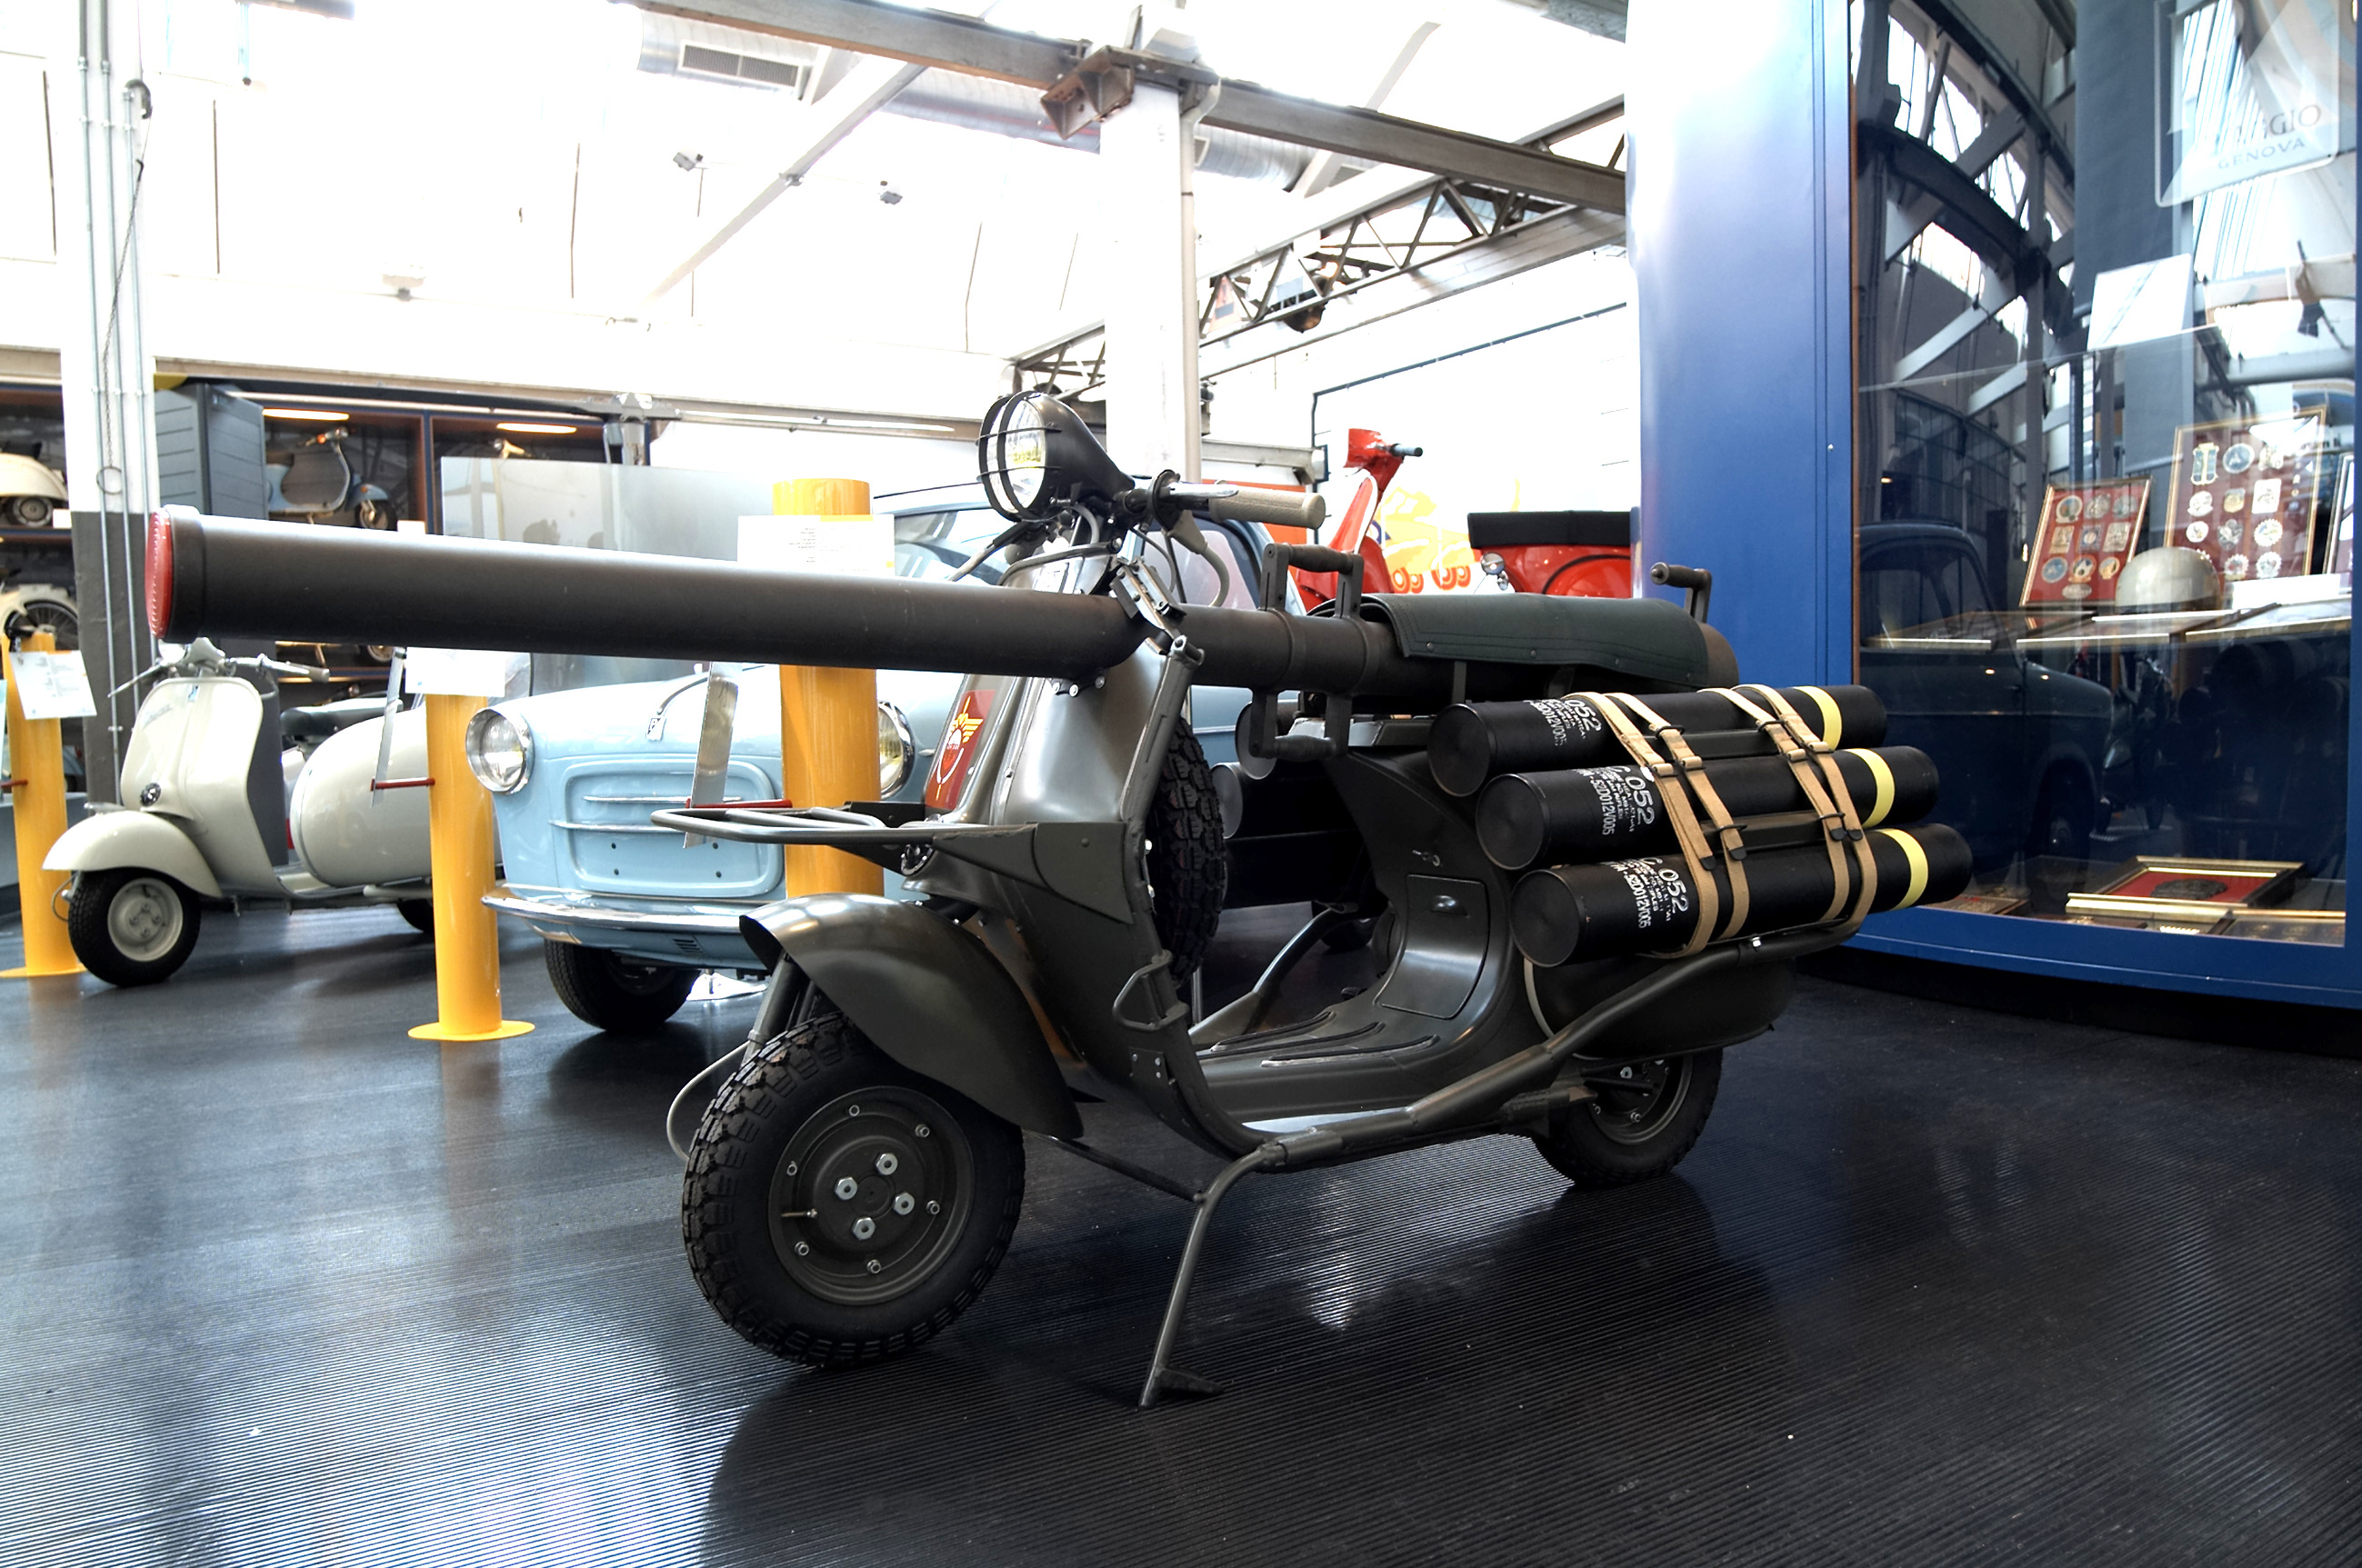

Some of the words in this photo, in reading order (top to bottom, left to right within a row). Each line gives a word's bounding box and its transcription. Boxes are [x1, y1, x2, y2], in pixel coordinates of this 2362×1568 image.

[2218, 137, 2306, 169] GENOVA
[1564, 699, 1602, 732] 052
[1626, 776, 1655, 824] 052
[1659, 868, 1688, 914] 052
